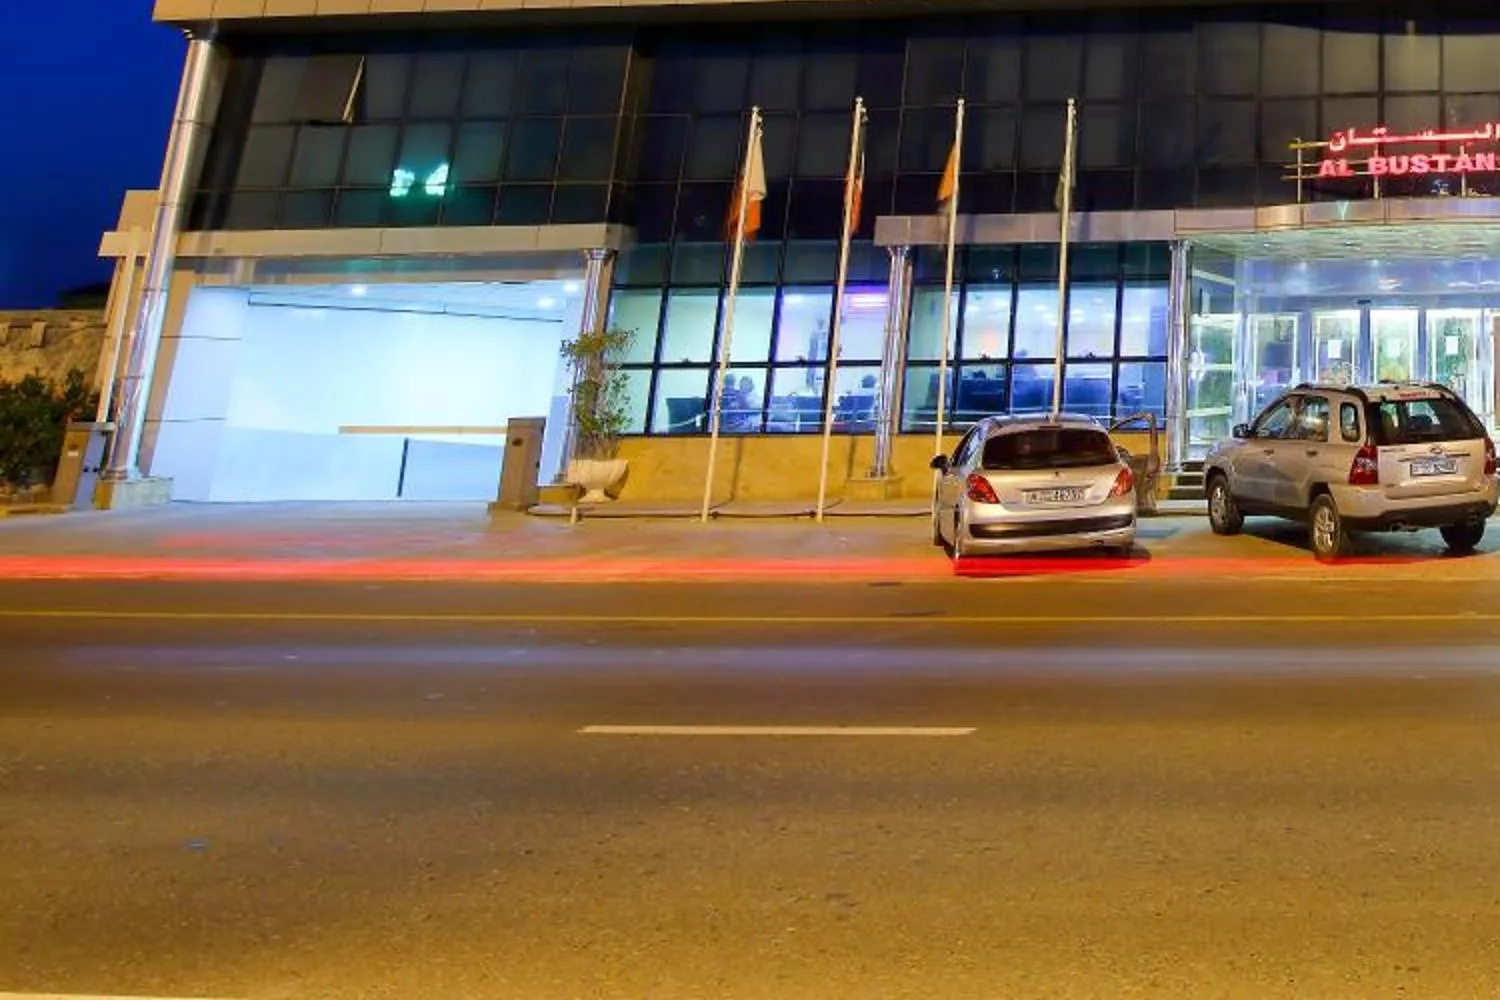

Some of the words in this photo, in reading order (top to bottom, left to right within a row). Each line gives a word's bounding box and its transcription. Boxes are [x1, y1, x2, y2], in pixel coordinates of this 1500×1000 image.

[1329, 122, 1500, 152] البستان
[1319, 159, 1354, 177] AL
[1368, 152, 1496, 175] BUSTAN
